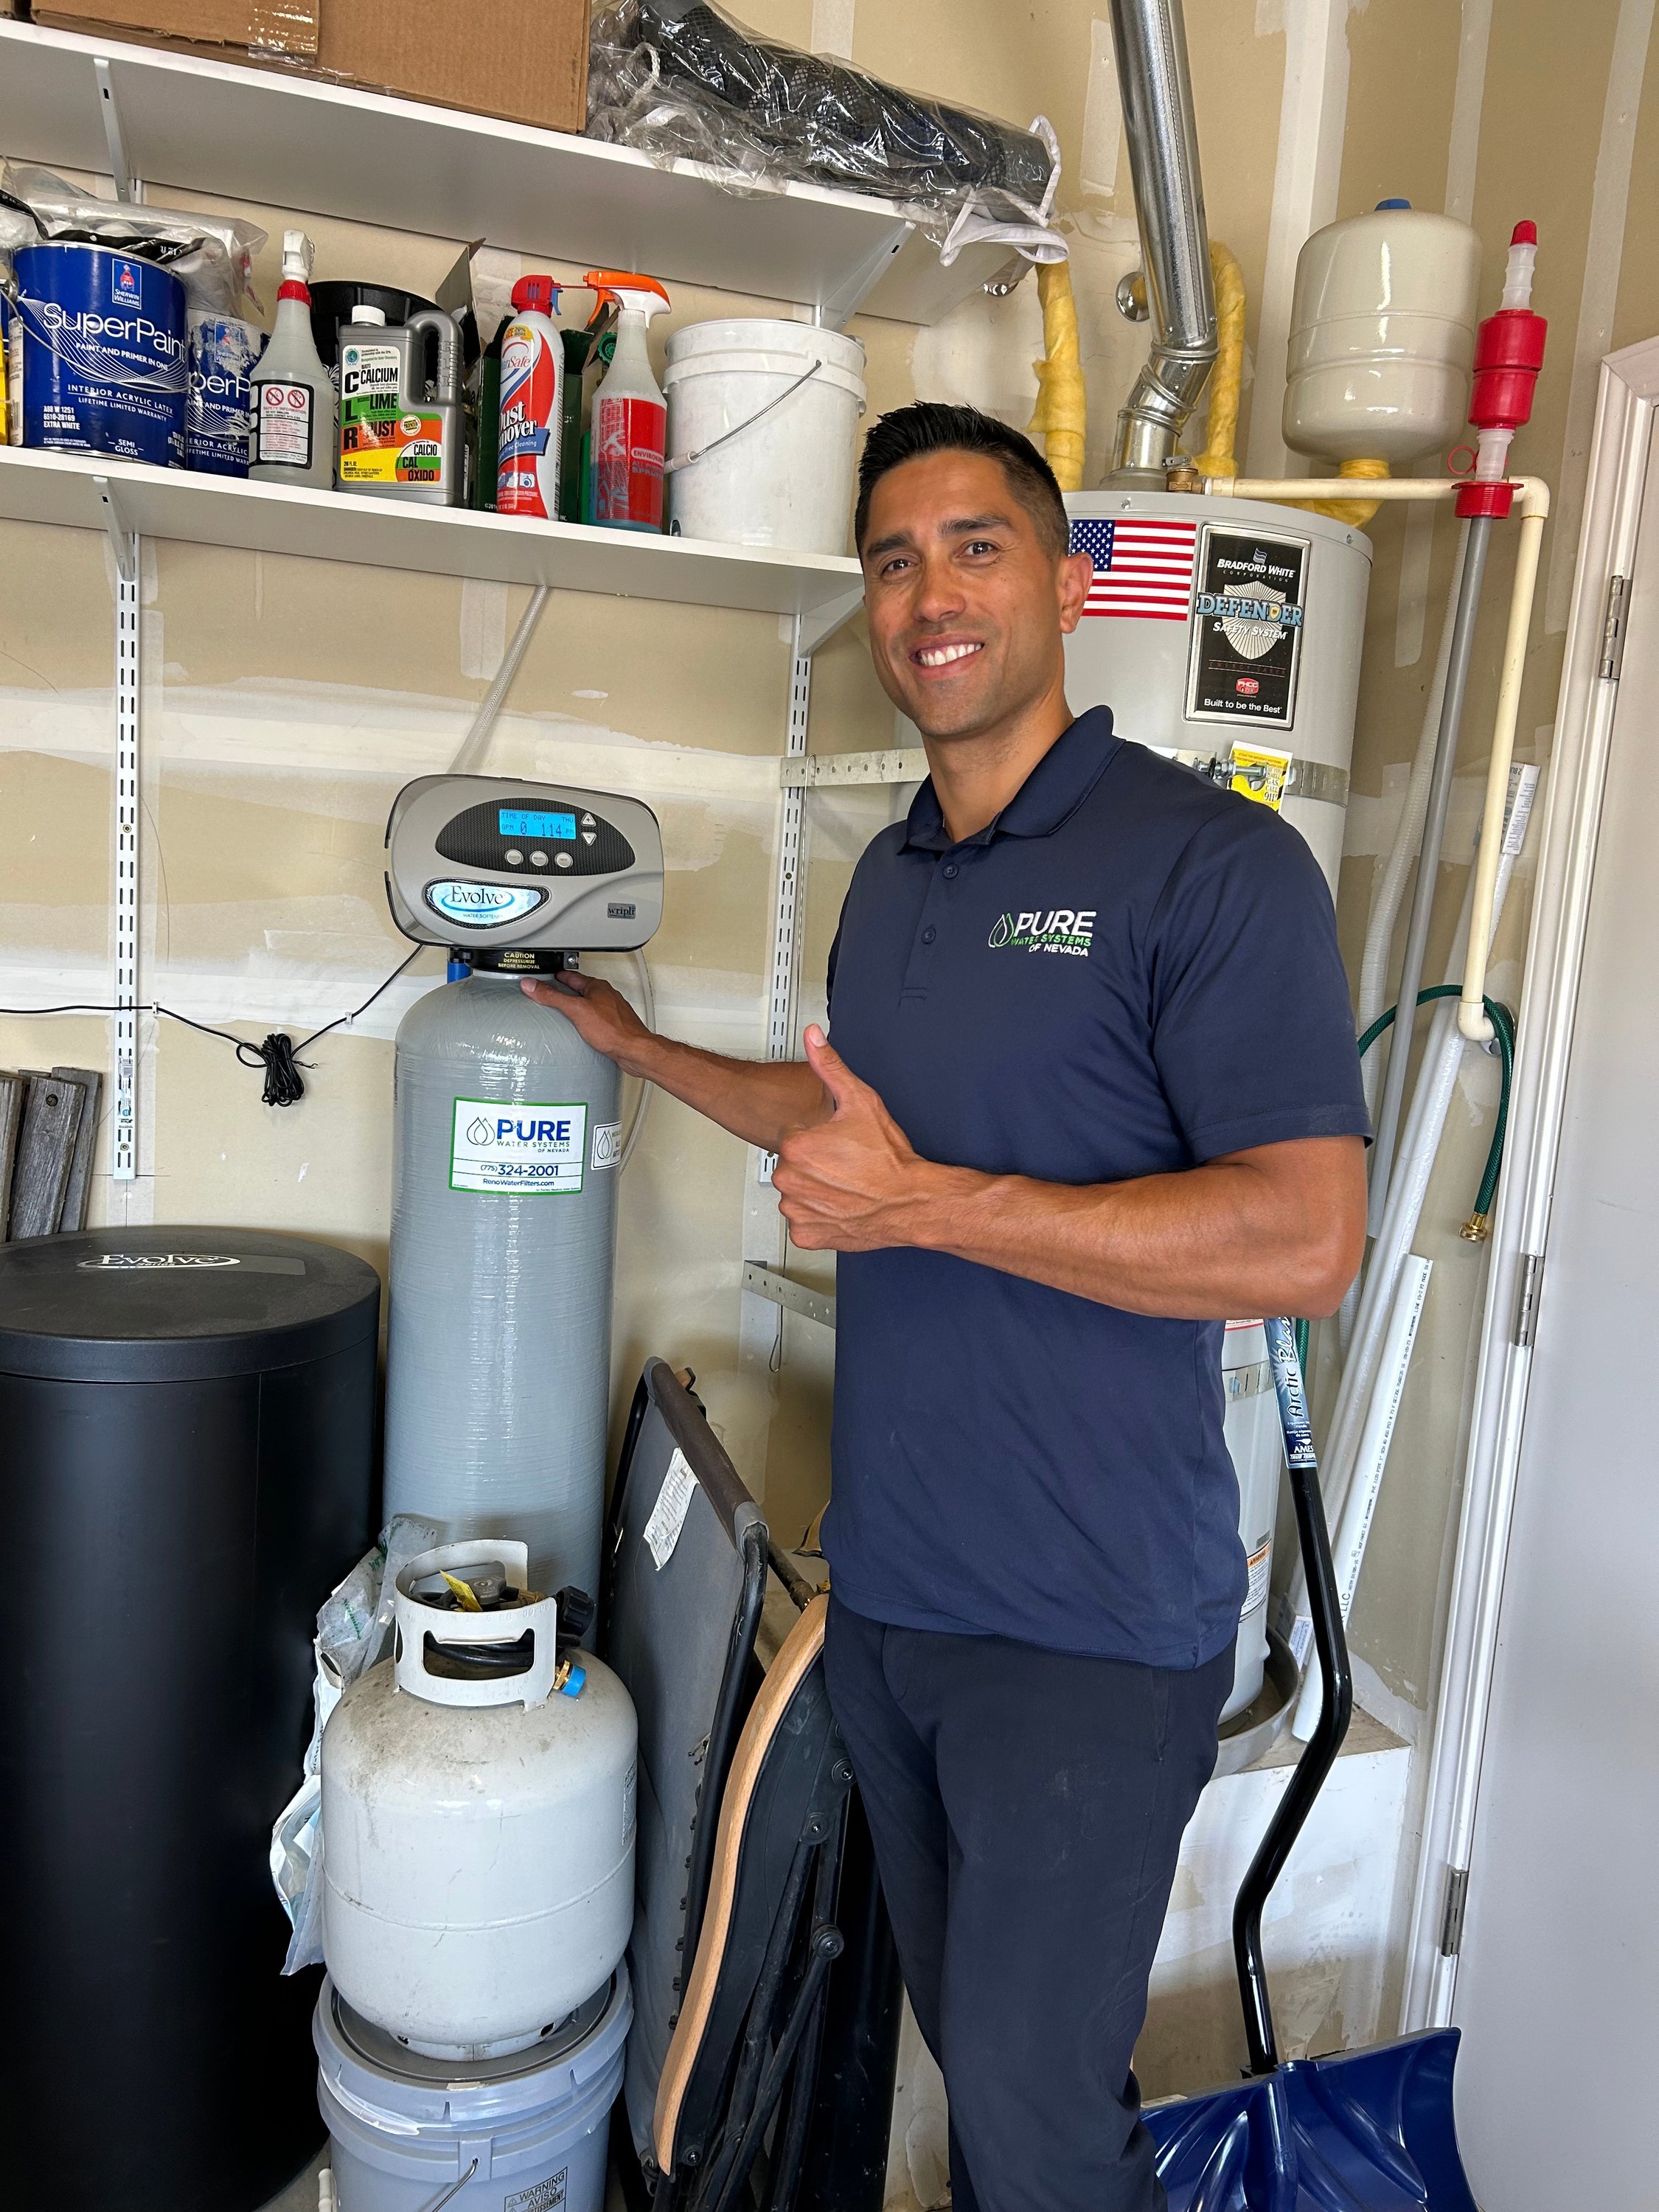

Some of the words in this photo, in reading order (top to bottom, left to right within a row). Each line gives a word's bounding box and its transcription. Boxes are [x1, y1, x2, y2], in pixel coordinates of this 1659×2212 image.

[114, 289, 140, 300] SHERWIN
[114, 294, 140, 306] WILLIAMS
[43, 303, 185, 363] SuperPaint
[76, 342, 101, 352] PAINT
[102, 346, 120, 356] AND
[121, 351, 147, 363] PRIMER
[147, 358, 156, 366] IN
[156, 361, 169, 370] ONE
[502, 355, 531, 371] anSafe
[344, 371, 360, 394] C
[361, 367, 398, 385] CALCIUM
[68, 384, 113, 397] INTERIOR
[116, 391, 152, 407] ACRYLIC
[154, 401, 173, 414] LATEX
[370, 393, 397, 410] LIME
[78, 397, 108, 407] LIFETIME
[110, 402, 136, 413] LIMITED
[138, 408, 167, 422] WARRANTY
[206, 402, 221, 411] AND
[222, 405, 245, 417] PRIMER
[345, 399, 358, 422] L
[44, 420, 61, 428] EXTRA
[61, 421, 80, 431] WHITE
[118, 438, 136, 447] SEMI
[344, 426, 358, 451] R
[498, 420, 538, 451] mover
[115, 445, 139, 456] GLOSS
[189, 437, 214, 448] ERIOR
[217, 442, 248, 456] ACRYLIC
[414, 444, 437, 456] CALCIO
[514, 440, 537, 449] Cleaning
[187, 448, 210, 456] IFETIME
[212, 451, 234, 462] LIMITED
[235, 457, 250, 466] WARR
[402, 456, 419, 469] CAL
[408, 468, 435, 481] ÓXIDO
[1217, 558, 1267, 573] BRADFORD
[1267, 565, 1295, 578] WHITE
[1222, 570, 1288, 582] CORPORATION
[1197, 593, 1304, 627] DEFENDER
[1212, 622, 1251, 635] SAFETY
[1252, 626, 1287, 640] SYSTEM
[1209, 661, 1251, 671] ENERGY
[1204, 698, 1223, 708] Built
[1225, 700, 1234, 709] to
[1236, 701, 1247, 709] be
[1248, 703, 1262, 712] the
[501, 812, 518, 820] TIME
[450, 886, 504, 905] Evolve
[1013, 909, 1097, 938] PURE
[1011, 935, 1038, 947] WATER
[1040, 933, 1092, 947] SYSTEMS
[1029, 944, 1041, 953] OF
[1043, 944, 1089, 957] NEVADA
[496, 1119, 571, 1141] PURE
[496, 1140, 529, 1148] WATER
[480, 1164, 498, 1173] (775)
[498, 1164, 559, 1177] 324-2001
[483, 1178, 554, 1187] RenoWaterFilters.com
[96, 1254, 215, 1265] Evolve
[1276, 1317, 1298, 1363] Blas
[1286, 1368, 1304, 1418] Arctic
[1294, 1445, 1314, 1453] AMES
[1340, 1593, 1351, 1612] LLC
[519, 2171, 565, 2202] WARNING
[528, 2187, 557, 2209] AVISO
[528, 2190, 564, 2212] RTISSEMENT
